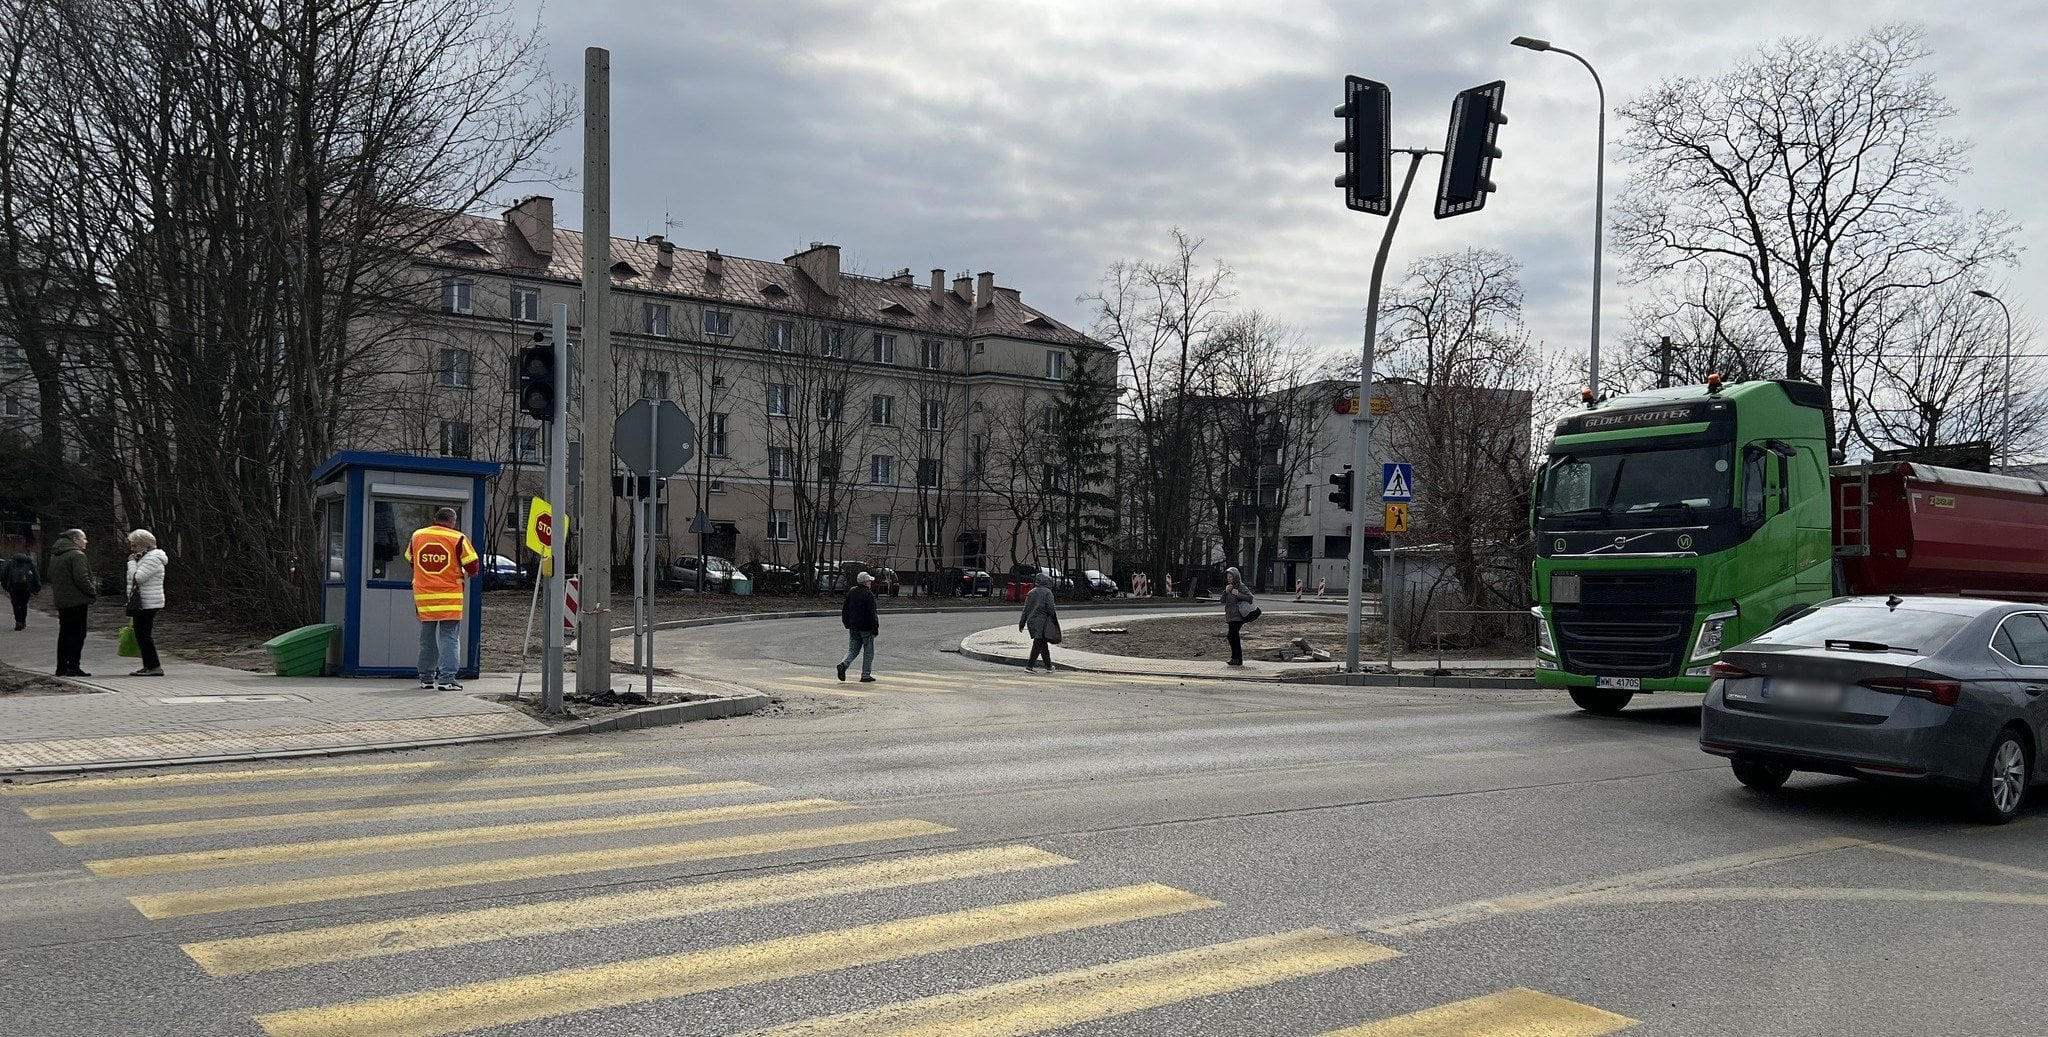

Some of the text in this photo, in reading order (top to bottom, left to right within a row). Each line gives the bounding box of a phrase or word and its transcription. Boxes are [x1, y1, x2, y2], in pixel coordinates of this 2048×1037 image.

[1585, 409, 1690, 427] GLOBETROTTER
[537, 521, 552, 536] STO
[421, 553, 446, 563] STOP
[1617, 679, 1639, 687] 4170S
